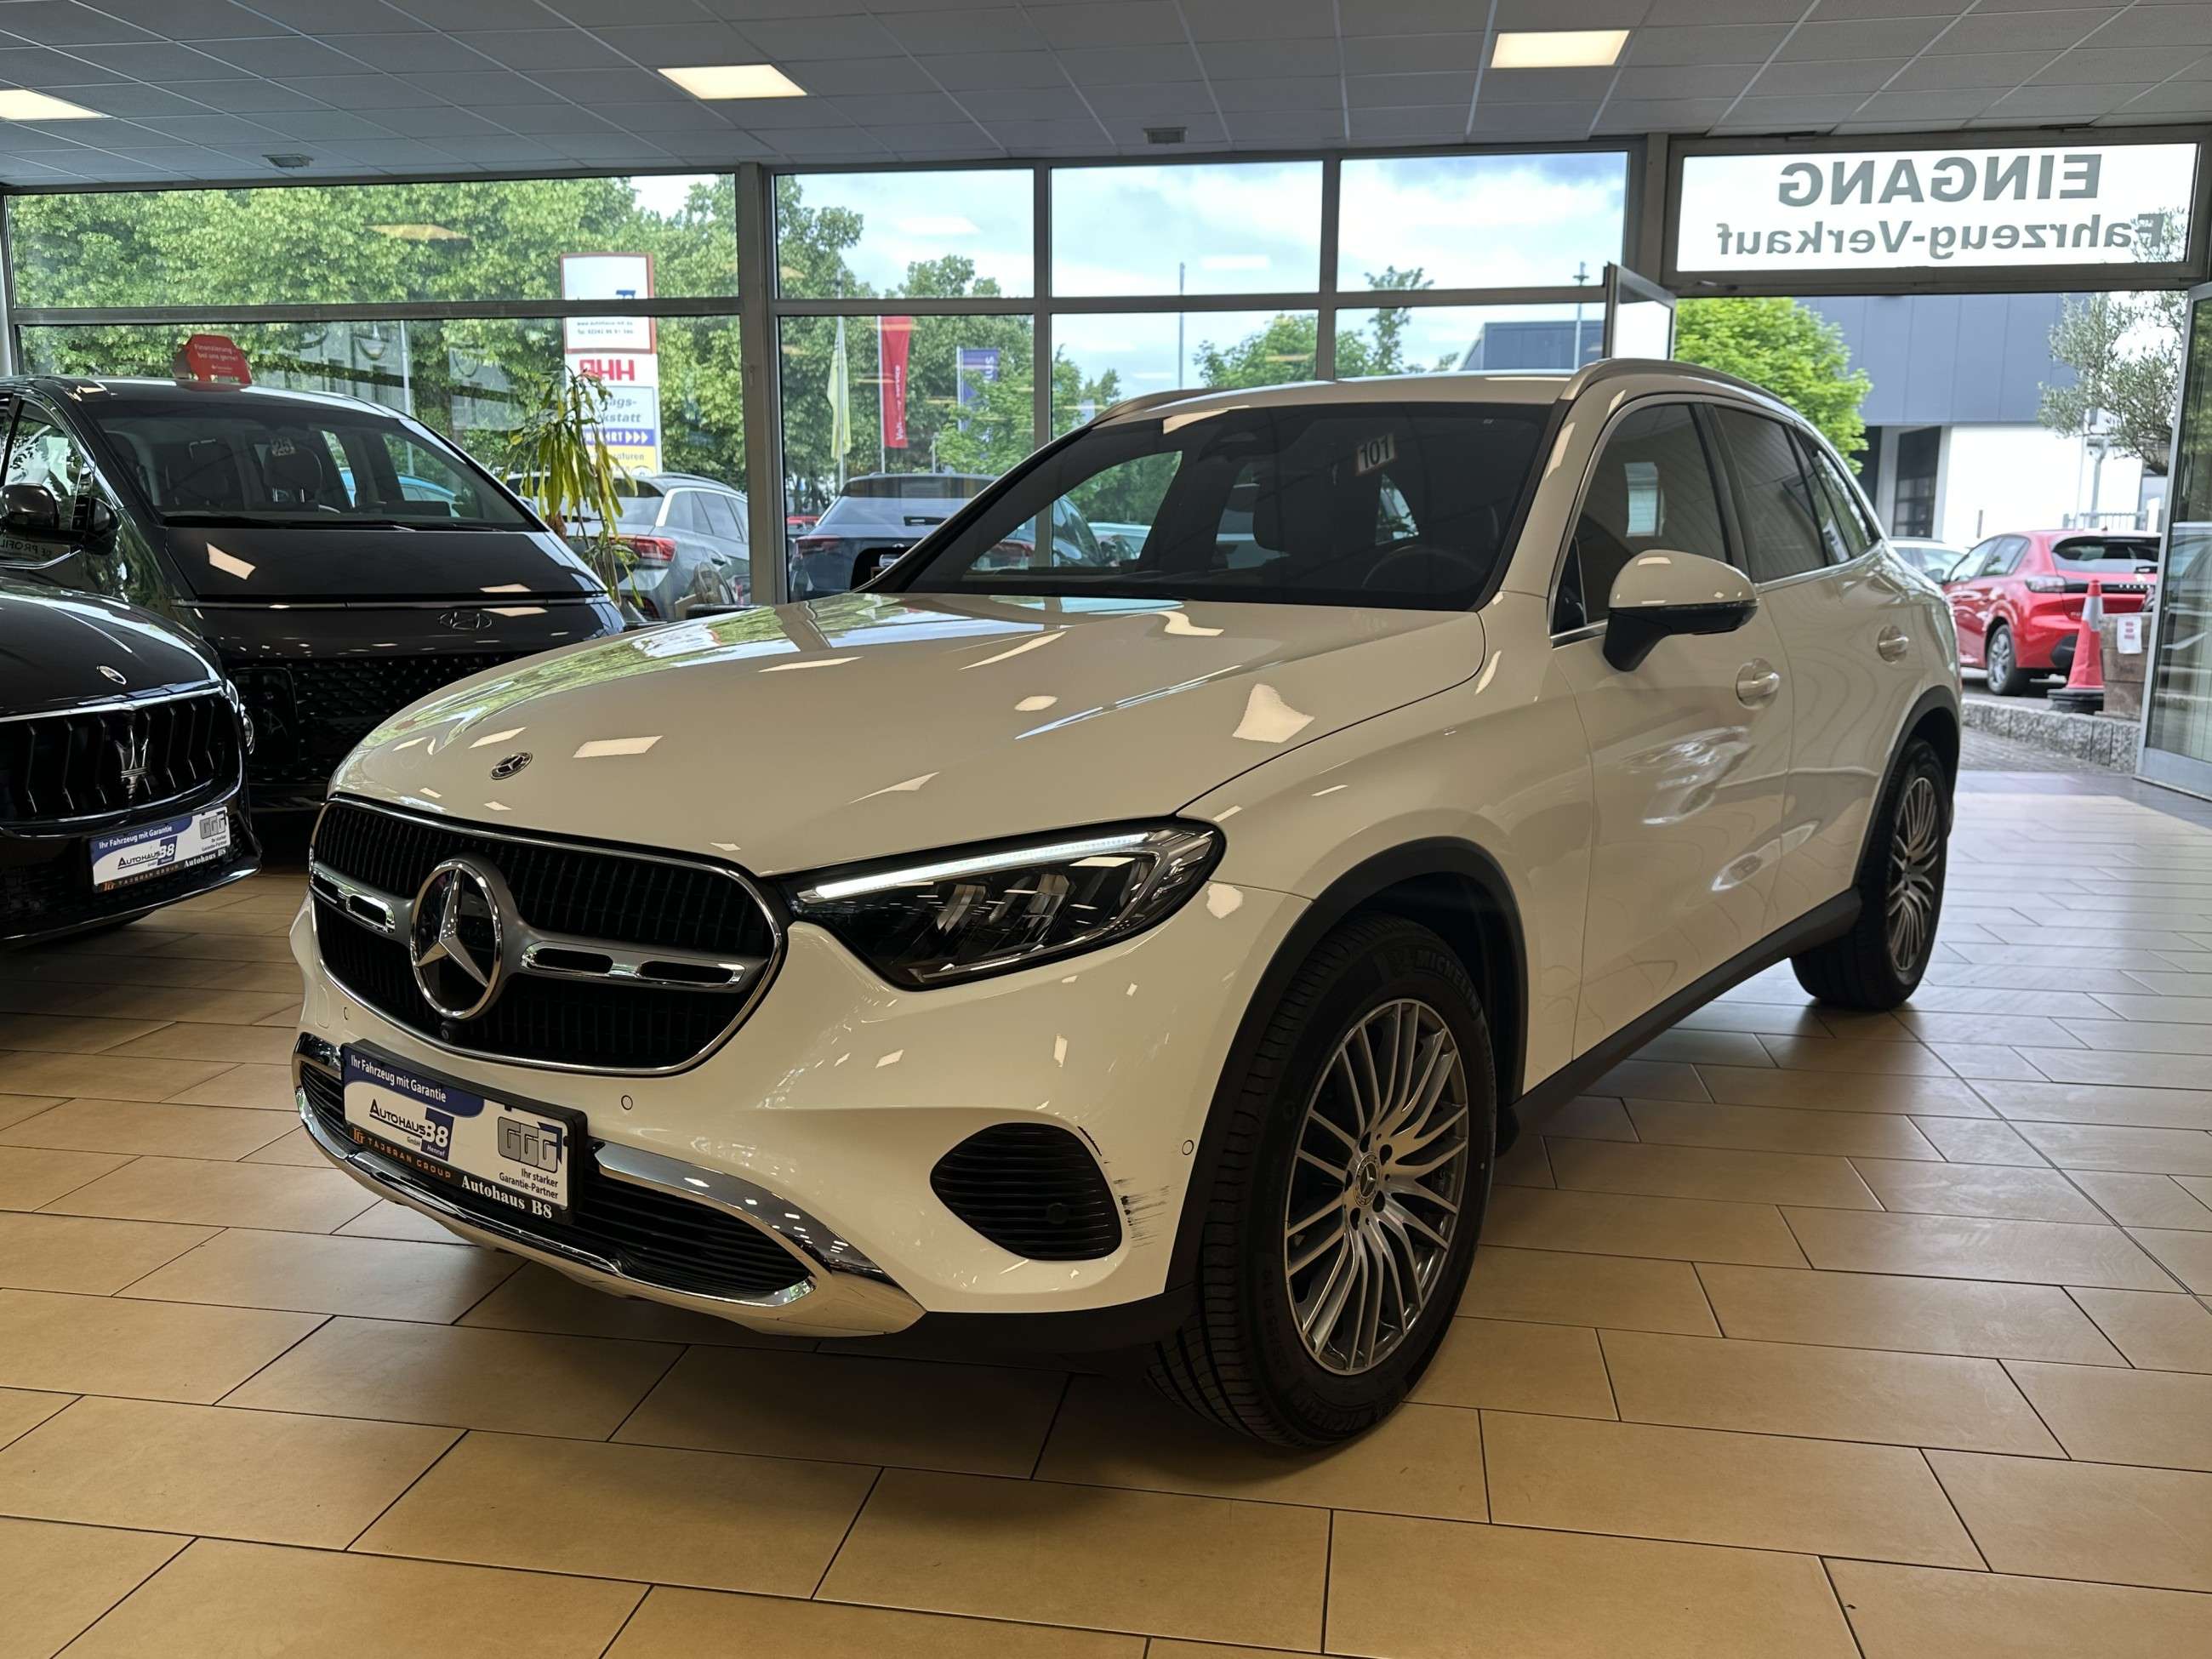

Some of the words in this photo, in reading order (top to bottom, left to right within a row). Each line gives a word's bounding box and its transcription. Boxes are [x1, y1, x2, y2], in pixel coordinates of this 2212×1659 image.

[1360, 435, 1390, 470] 101
[99, 841, 109, 850] Ihr
[109, 835, 139, 848] Fahrzeug
[138, 830, 149, 841] mit
[149, 824, 173, 837] Garantie
[351, 1053, 362, 1069] Ihr
[361, 1058, 396, 1086] Fahrzeug
[396, 1075, 410, 1090] mit
[410, 1078, 448, 1103] Garantie
[499, 1172, 559, 1200] Garantie-Partner
[521, 1168, 532, 1178] Ihr
[532, 1172, 559, 1188] starker
[461, 1175, 526, 1210] Autohaus
[531, 1199, 553, 1219] B8
